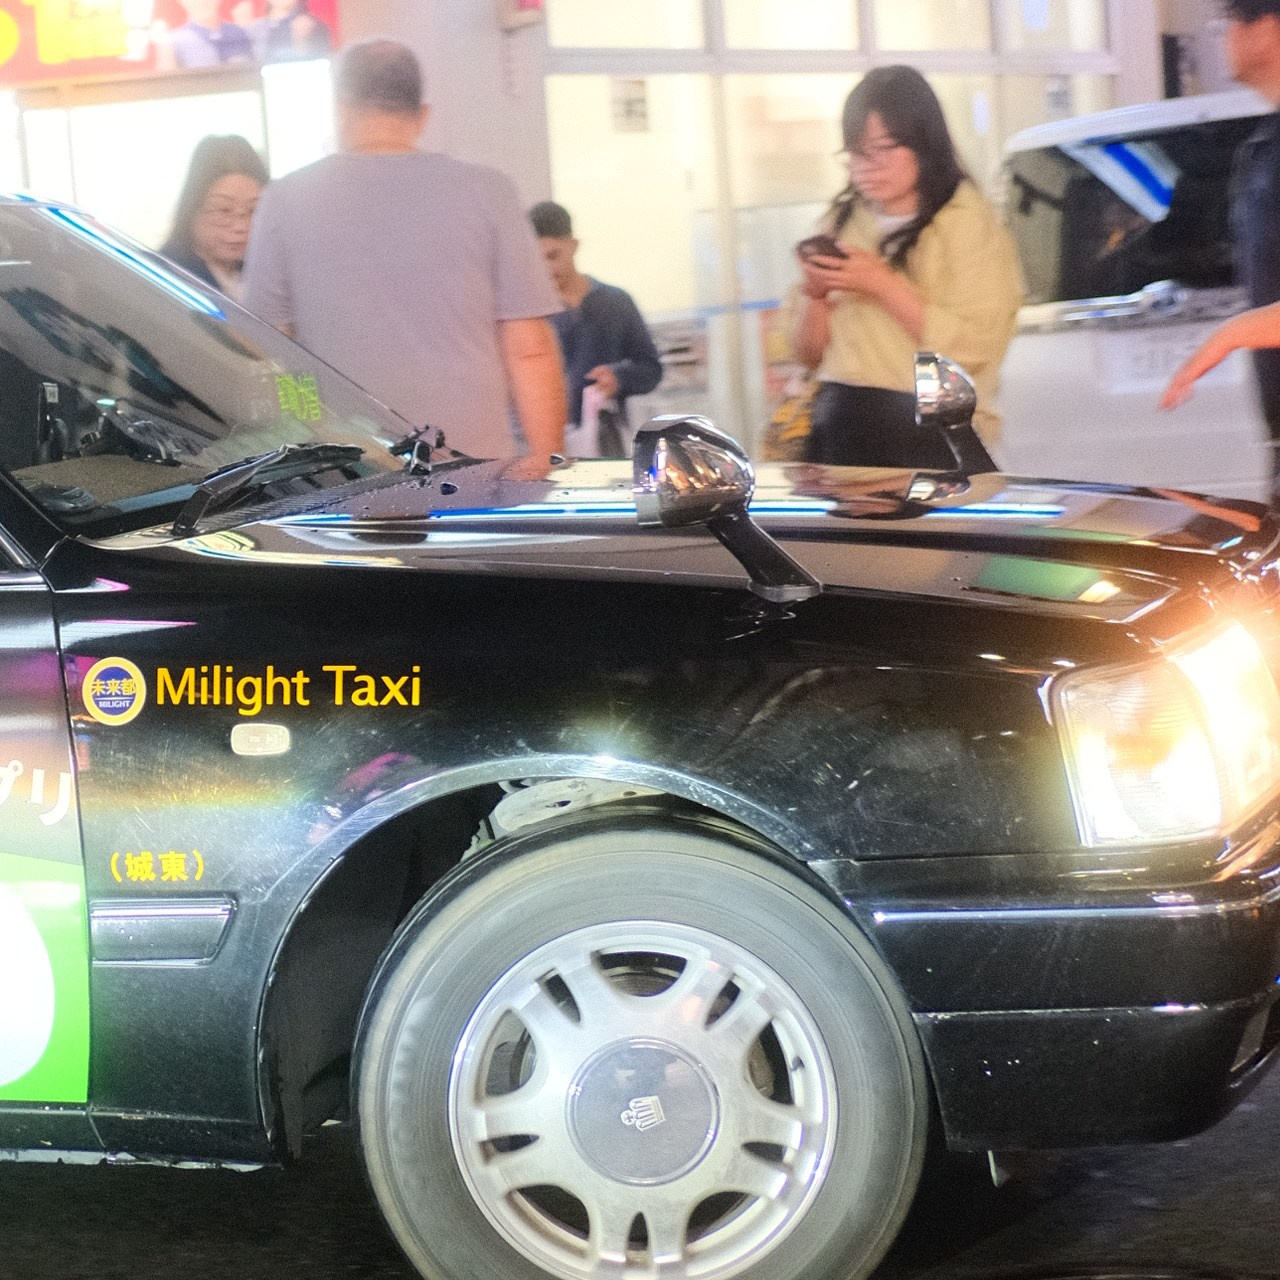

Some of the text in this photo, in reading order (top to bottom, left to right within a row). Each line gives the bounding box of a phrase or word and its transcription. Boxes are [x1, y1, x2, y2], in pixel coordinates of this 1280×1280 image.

[91, 678, 137, 696] 未来都
[156, 665, 421, 716] Milight Taxi
[98, 700, 131, 709] MILIGHT
